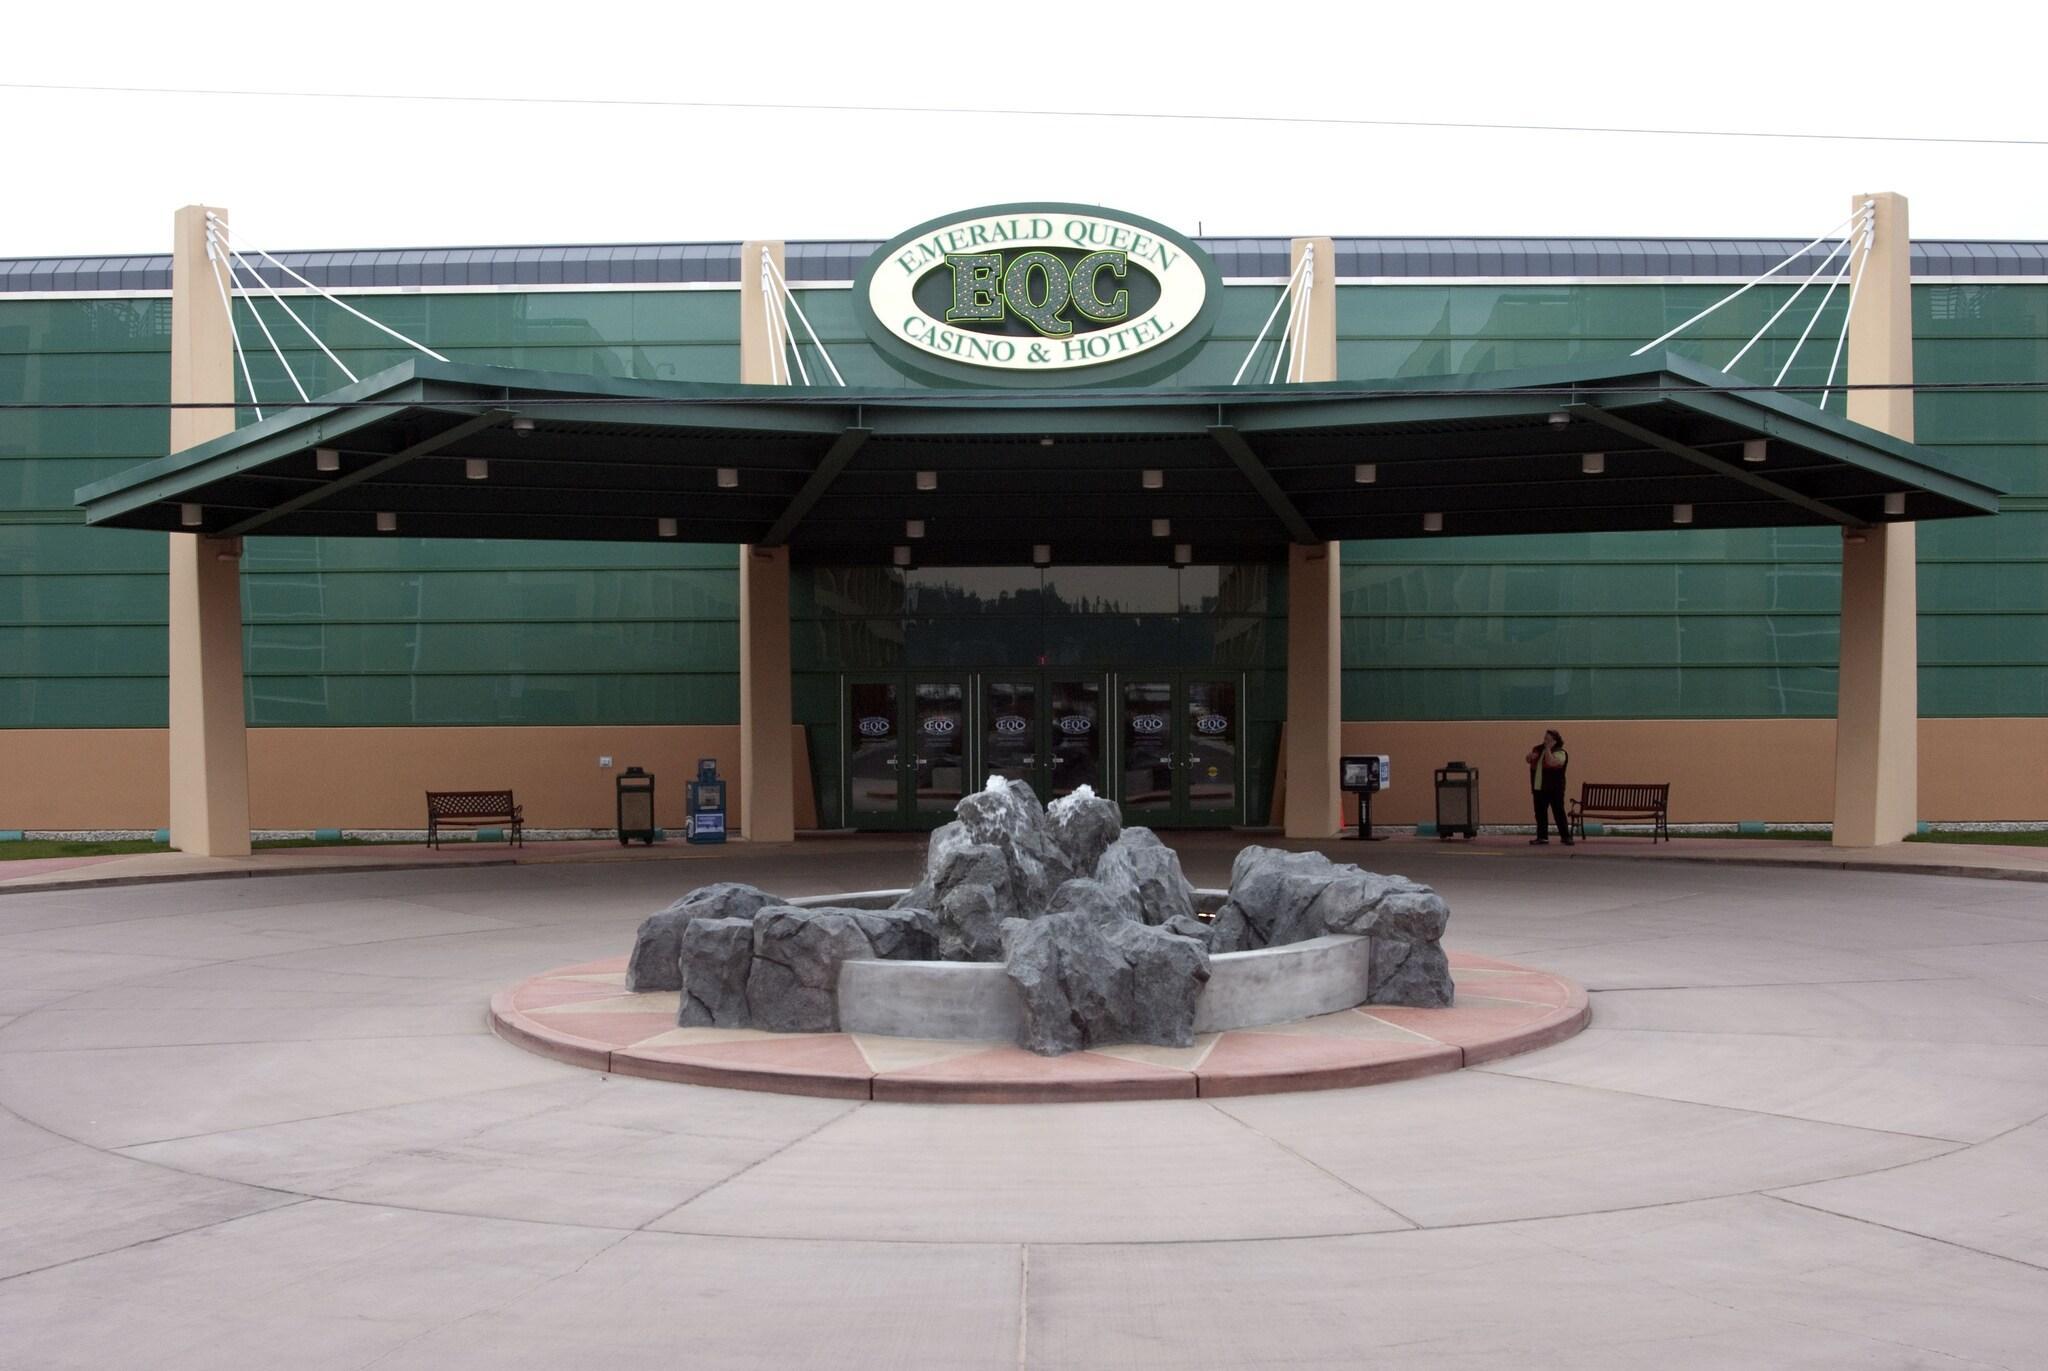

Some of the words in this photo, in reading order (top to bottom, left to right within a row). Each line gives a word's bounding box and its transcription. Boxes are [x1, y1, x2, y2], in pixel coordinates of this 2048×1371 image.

[896, 219, 1051, 275] EMERALD
[1064, 220, 1178, 271] QUEEN
[945, 250, 1128, 336] EQC
[903, 316, 1014, 362] CASINO
[1027, 343, 1050, 362] &
[1062, 315, 1174, 361] HOTEL
[863, 721, 887, 732] EQC
[928, 720, 952, 732] EQC
[999, 719, 1023, 732] EQC
[1065, 719, 1089, 731] EQC
[1137, 719, 1161, 730] EQC
[1201, 719, 1225, 730] EQC
